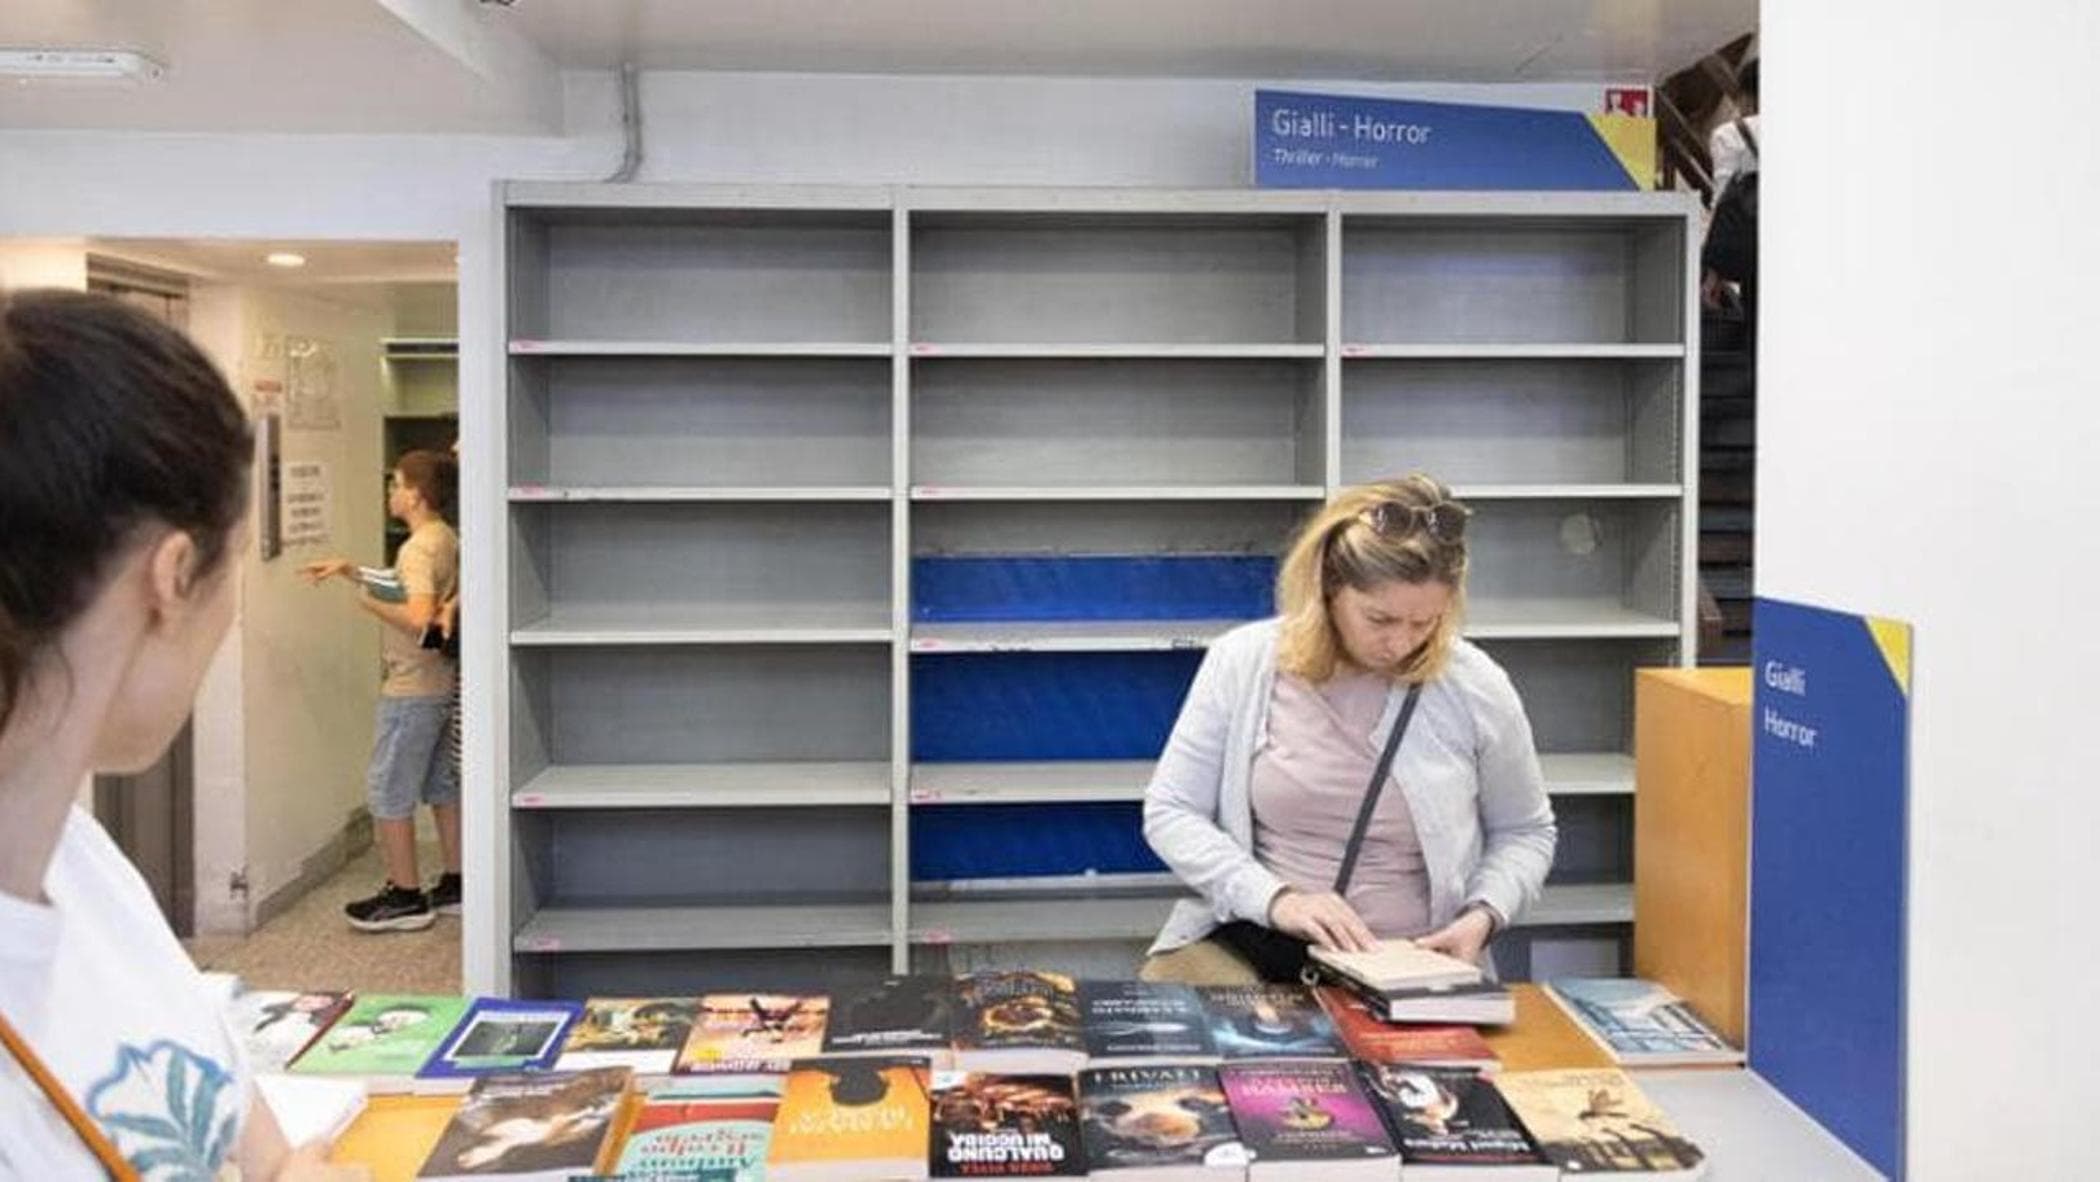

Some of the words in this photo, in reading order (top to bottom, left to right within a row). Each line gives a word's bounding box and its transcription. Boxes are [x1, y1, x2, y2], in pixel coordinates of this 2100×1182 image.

[1273, 108, 1335, 137] Gialli
[1353, 113, 1432, 144] Horror
[1764, 660, 1806, 696] Gialli
[1764, 703, 1818, 748] Horror
[947, 1145, 1065, 1162] QUALCUNO
[950, 1130, 1024, 1147] UCCIDA
